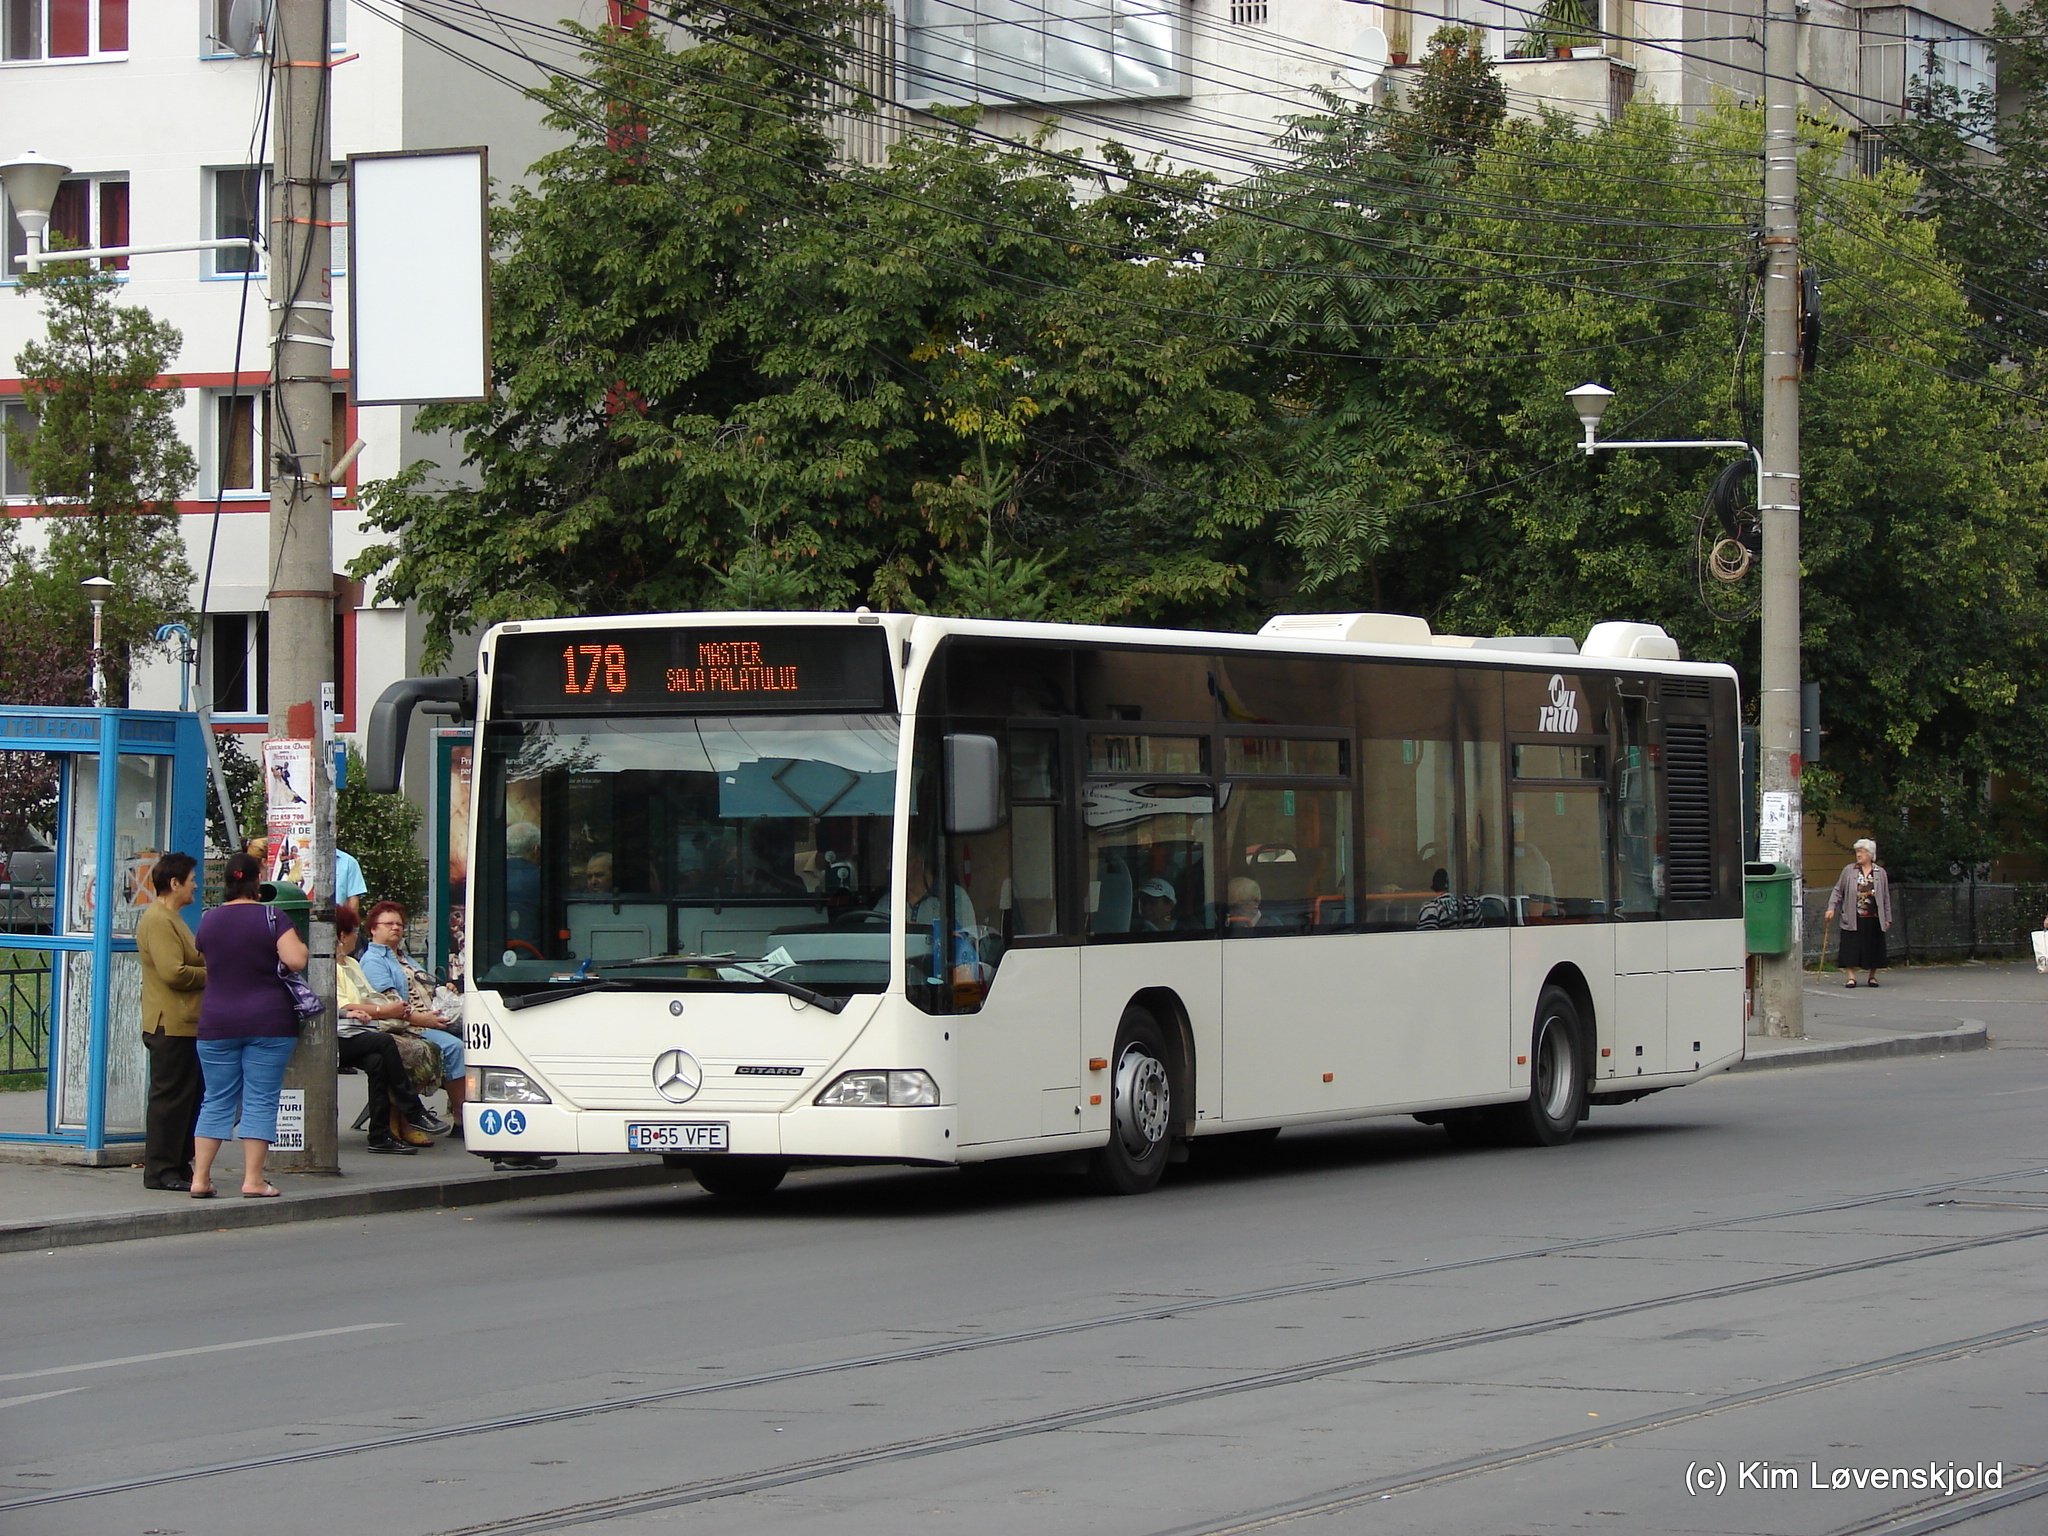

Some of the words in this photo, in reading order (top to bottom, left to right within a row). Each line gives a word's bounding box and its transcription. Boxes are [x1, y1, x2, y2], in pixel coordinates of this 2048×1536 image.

[699, 642, 763, 666] MASTER
[563, 645, 627, 693] 178
[666, 668, 705, 692] SALA
[710, 666, 798, 690] PALATULUI
[12, 719, 94, 738] TELEFON
[463, 1022, 492, 1050] 439
[738, 1067, 801, 1075] CITARO
[640, 1128, 652, 1145] B
[659, 1128, 678, 1145] 55
[685, 1128, 721, 1145] VFE
